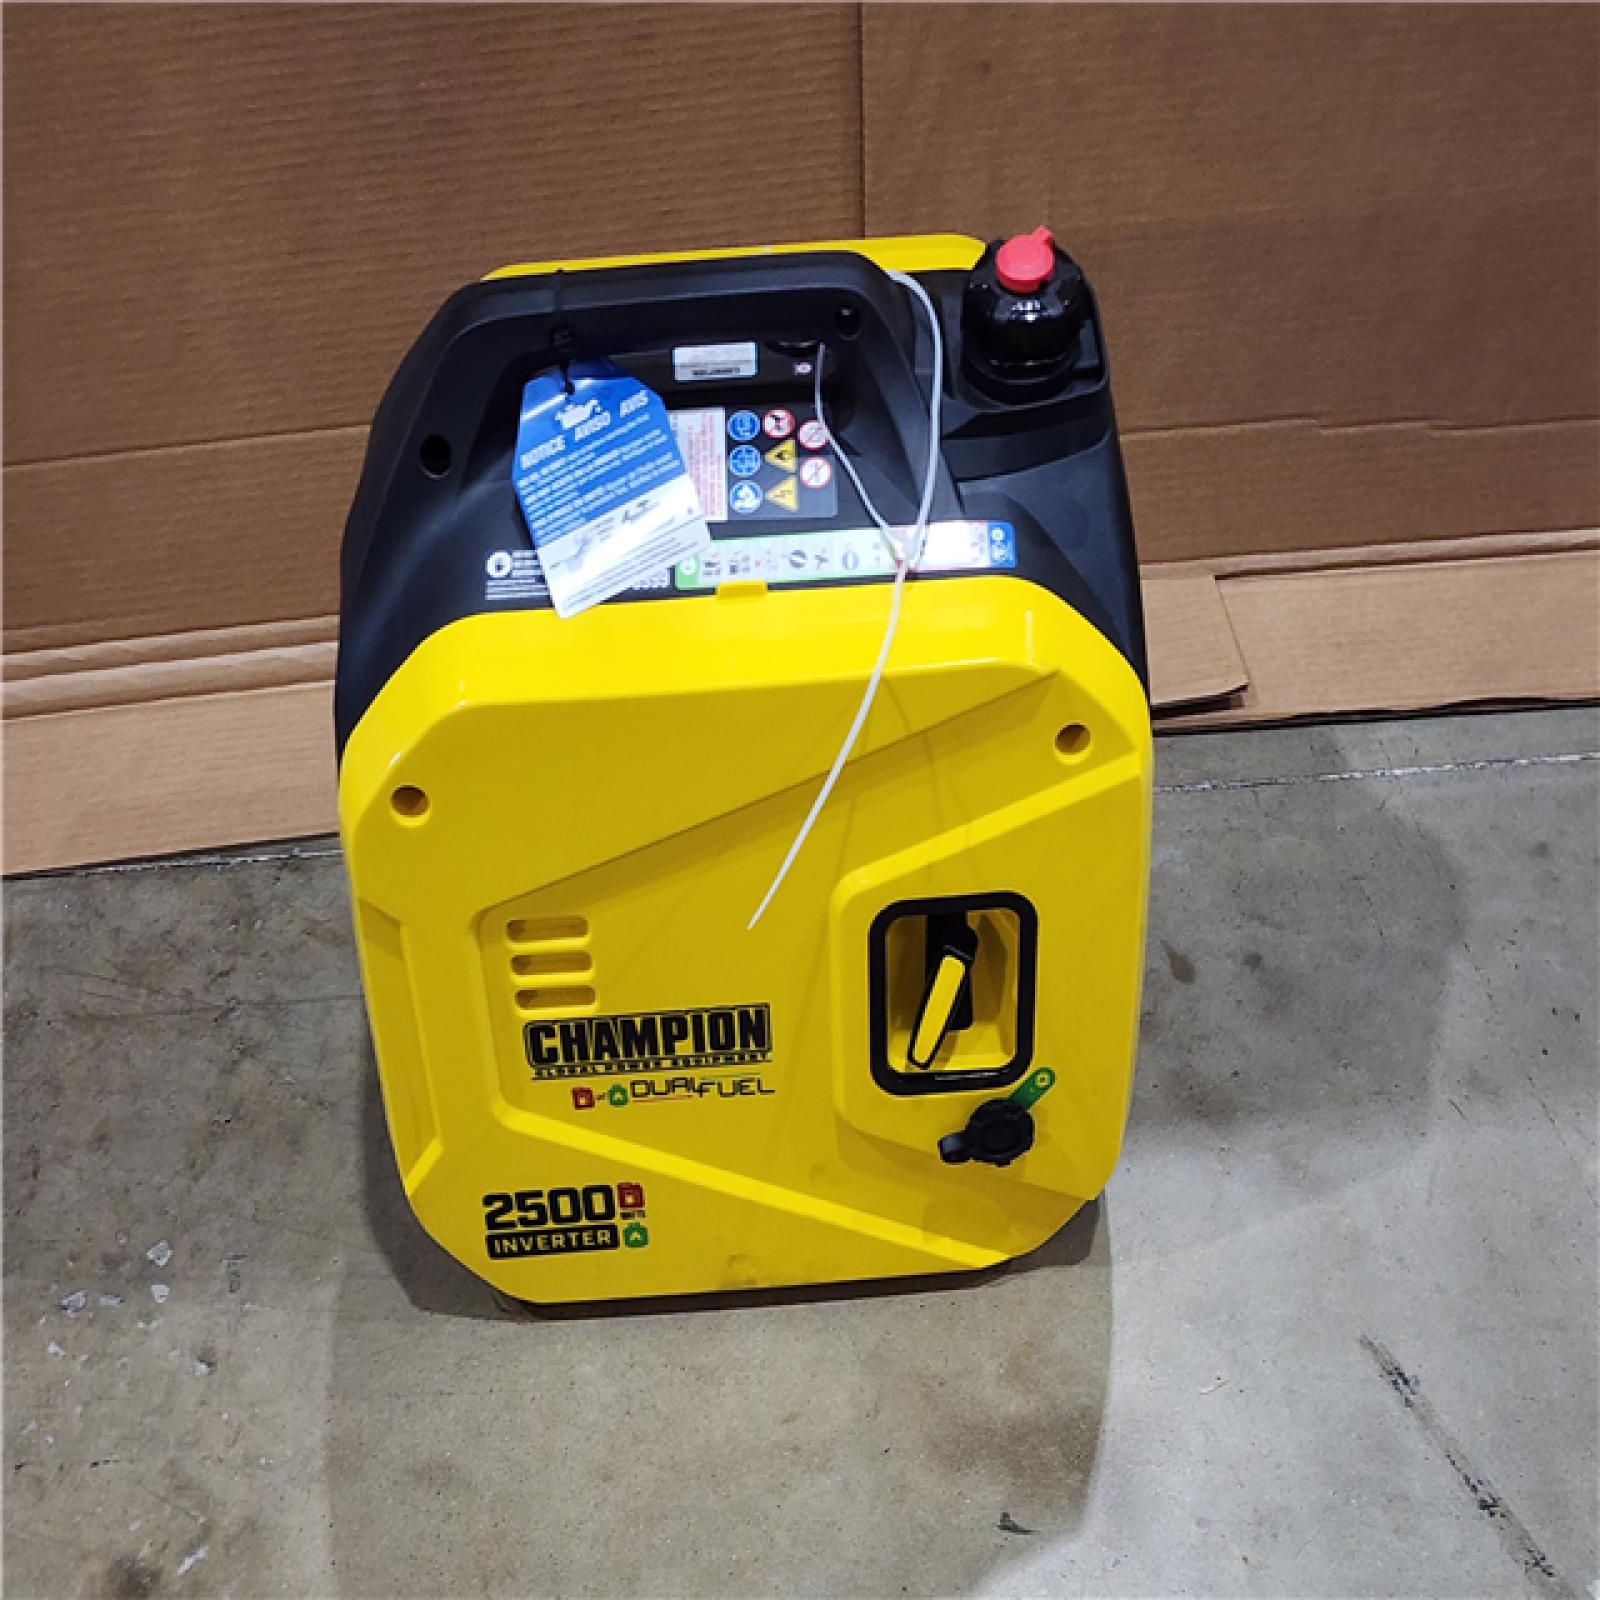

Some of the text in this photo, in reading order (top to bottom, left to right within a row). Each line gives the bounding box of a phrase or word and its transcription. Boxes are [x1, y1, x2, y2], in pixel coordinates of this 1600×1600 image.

[527, 1007, 767, 1063] CHAMPION
[483, 1184, 615, 1230] 2500
[494, 1230, 611, 1254] INVERTER
